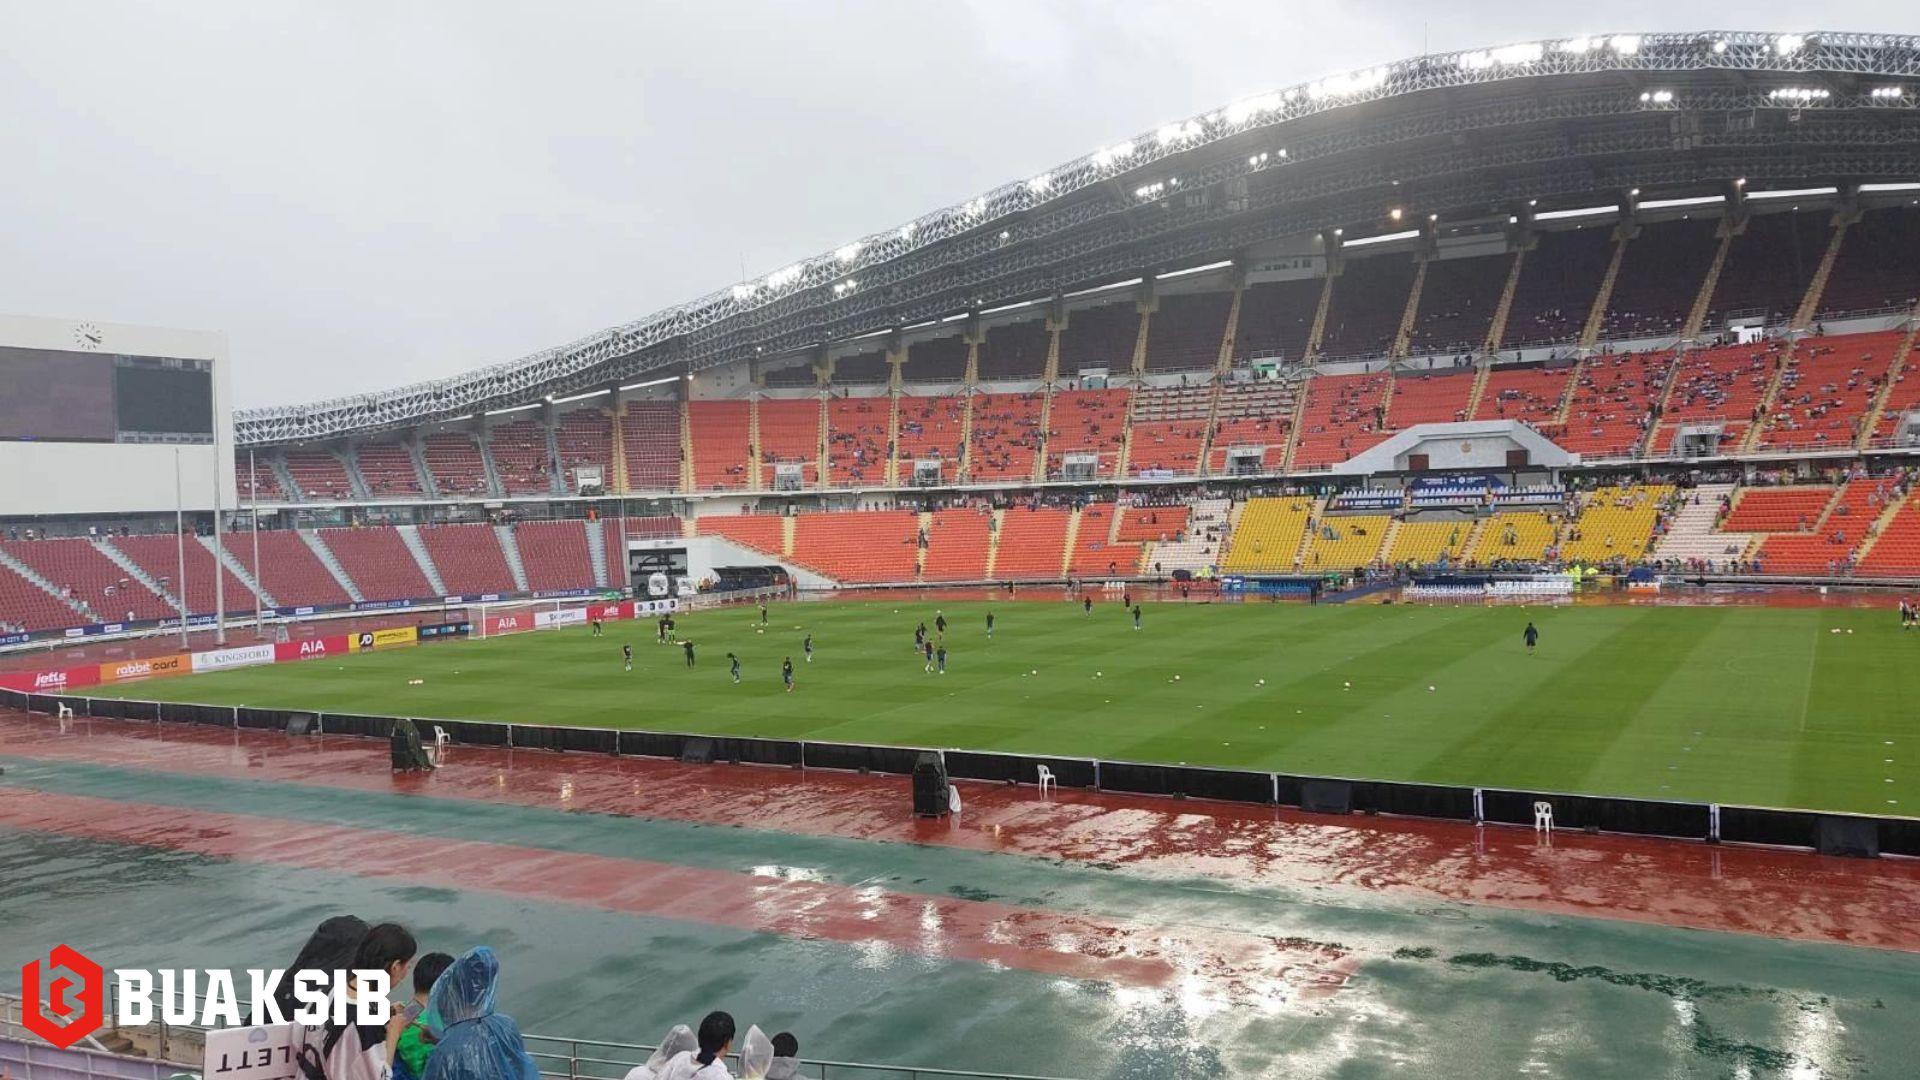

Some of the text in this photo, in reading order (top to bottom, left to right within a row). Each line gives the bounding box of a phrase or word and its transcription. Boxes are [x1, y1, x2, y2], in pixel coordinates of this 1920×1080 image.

[498, 617, 518, 629] AIA
[299, 640, 325, 654] AIA
[361, 634, 373, 646] JD
[214, 649, 270, 664] KINGSFORD
[116, 659, 178, 676] rabbit card
[34, 671, 67, 687] jetts
